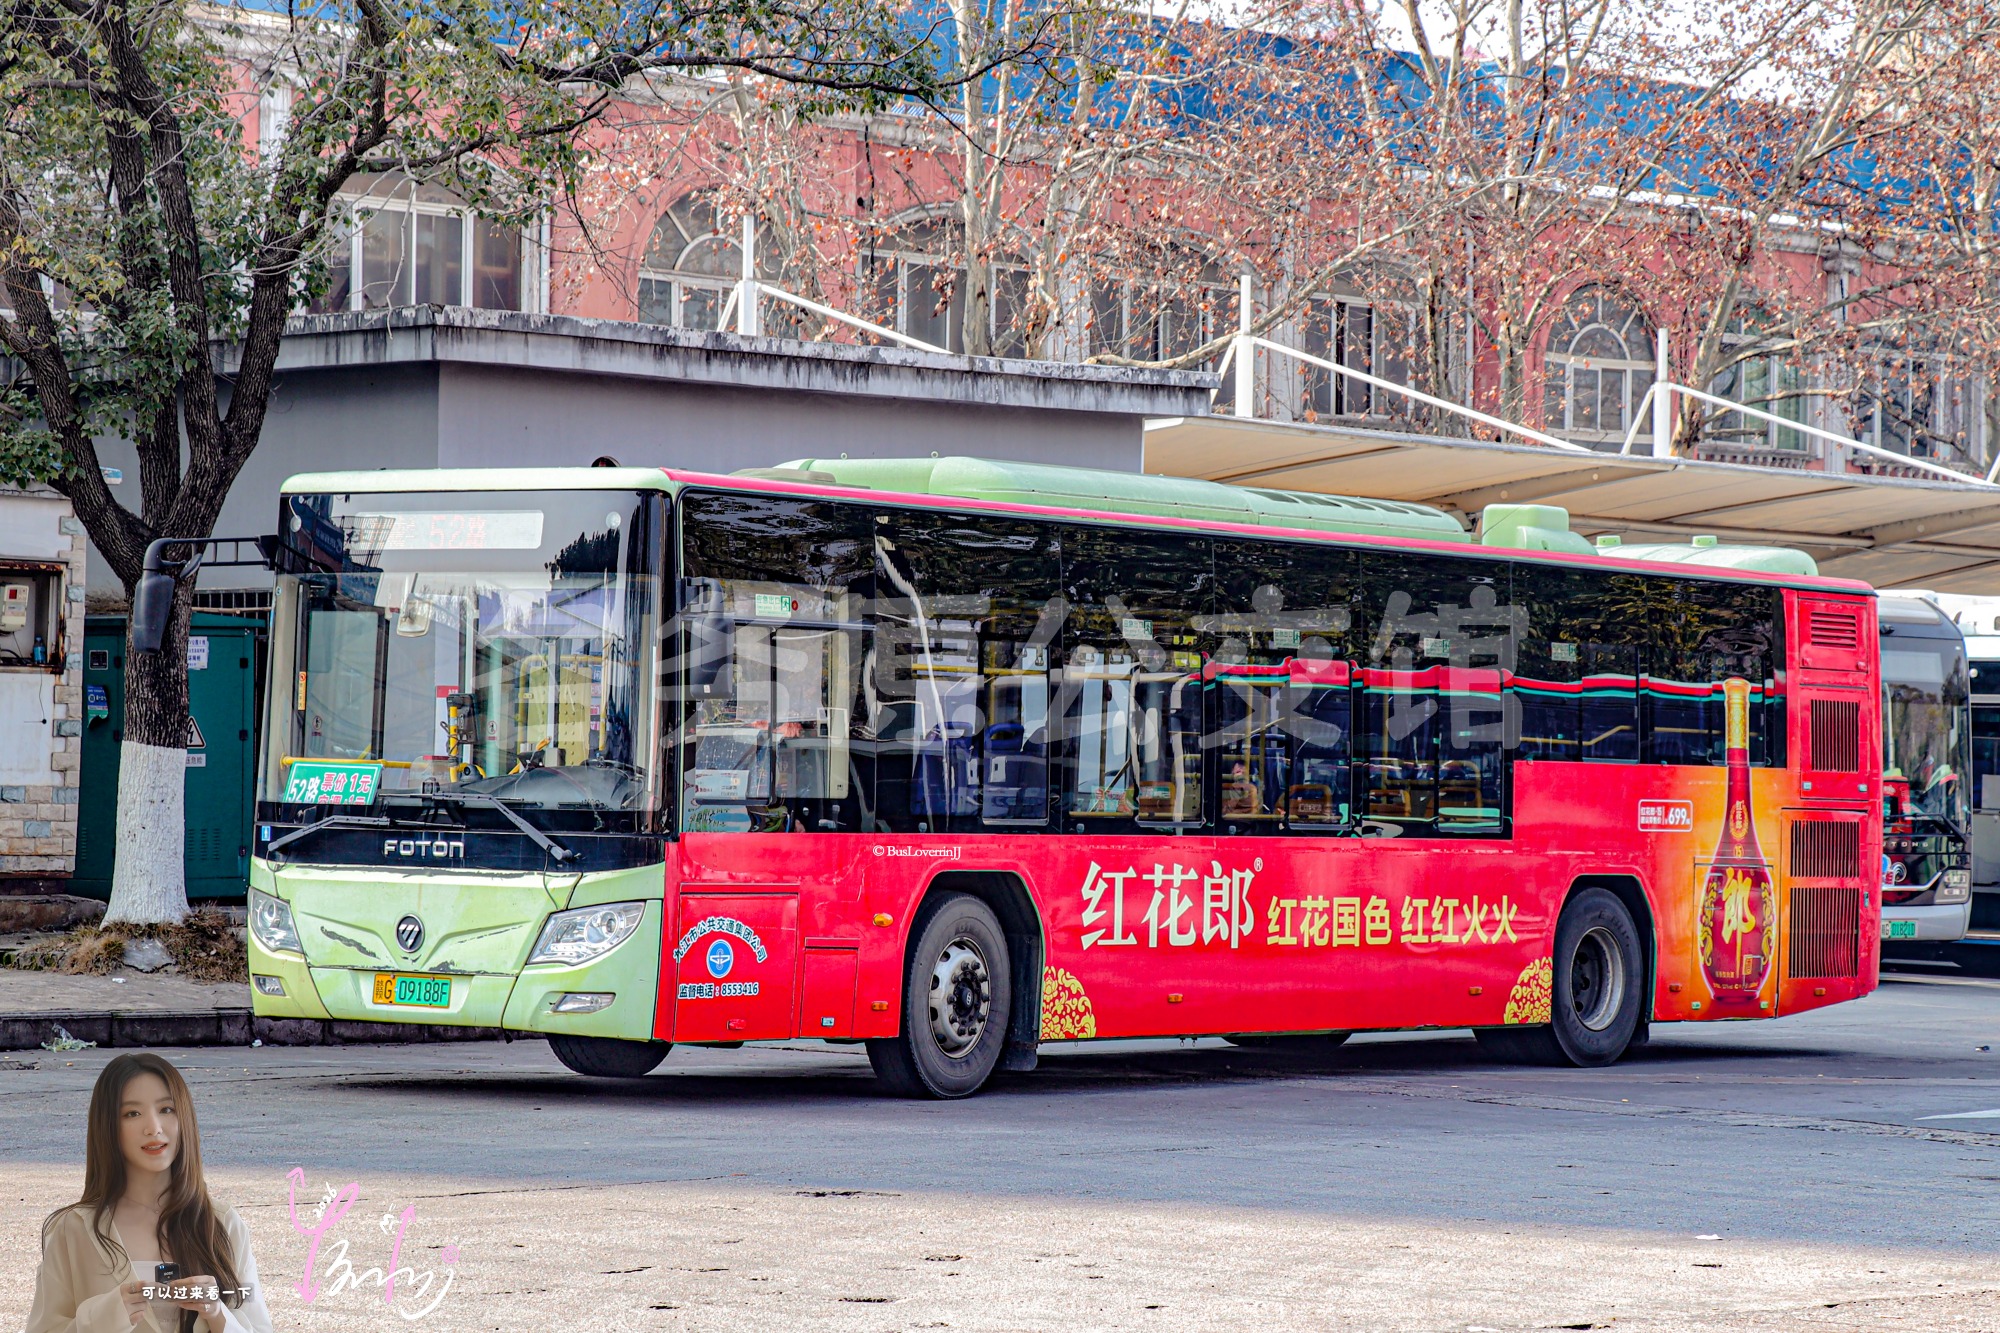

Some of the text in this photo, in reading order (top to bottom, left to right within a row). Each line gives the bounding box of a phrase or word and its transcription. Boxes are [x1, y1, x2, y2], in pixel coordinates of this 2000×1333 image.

[287, 776, 320, 803] 52路
[384, 840, 464, 858] FOTON
[1081, 861, 1255, 950] 红花郎
[1266, 895, 1518, 948] 红花国色 红红火火
[673, 916, 767, 963] 九江市公共交通集团公司
